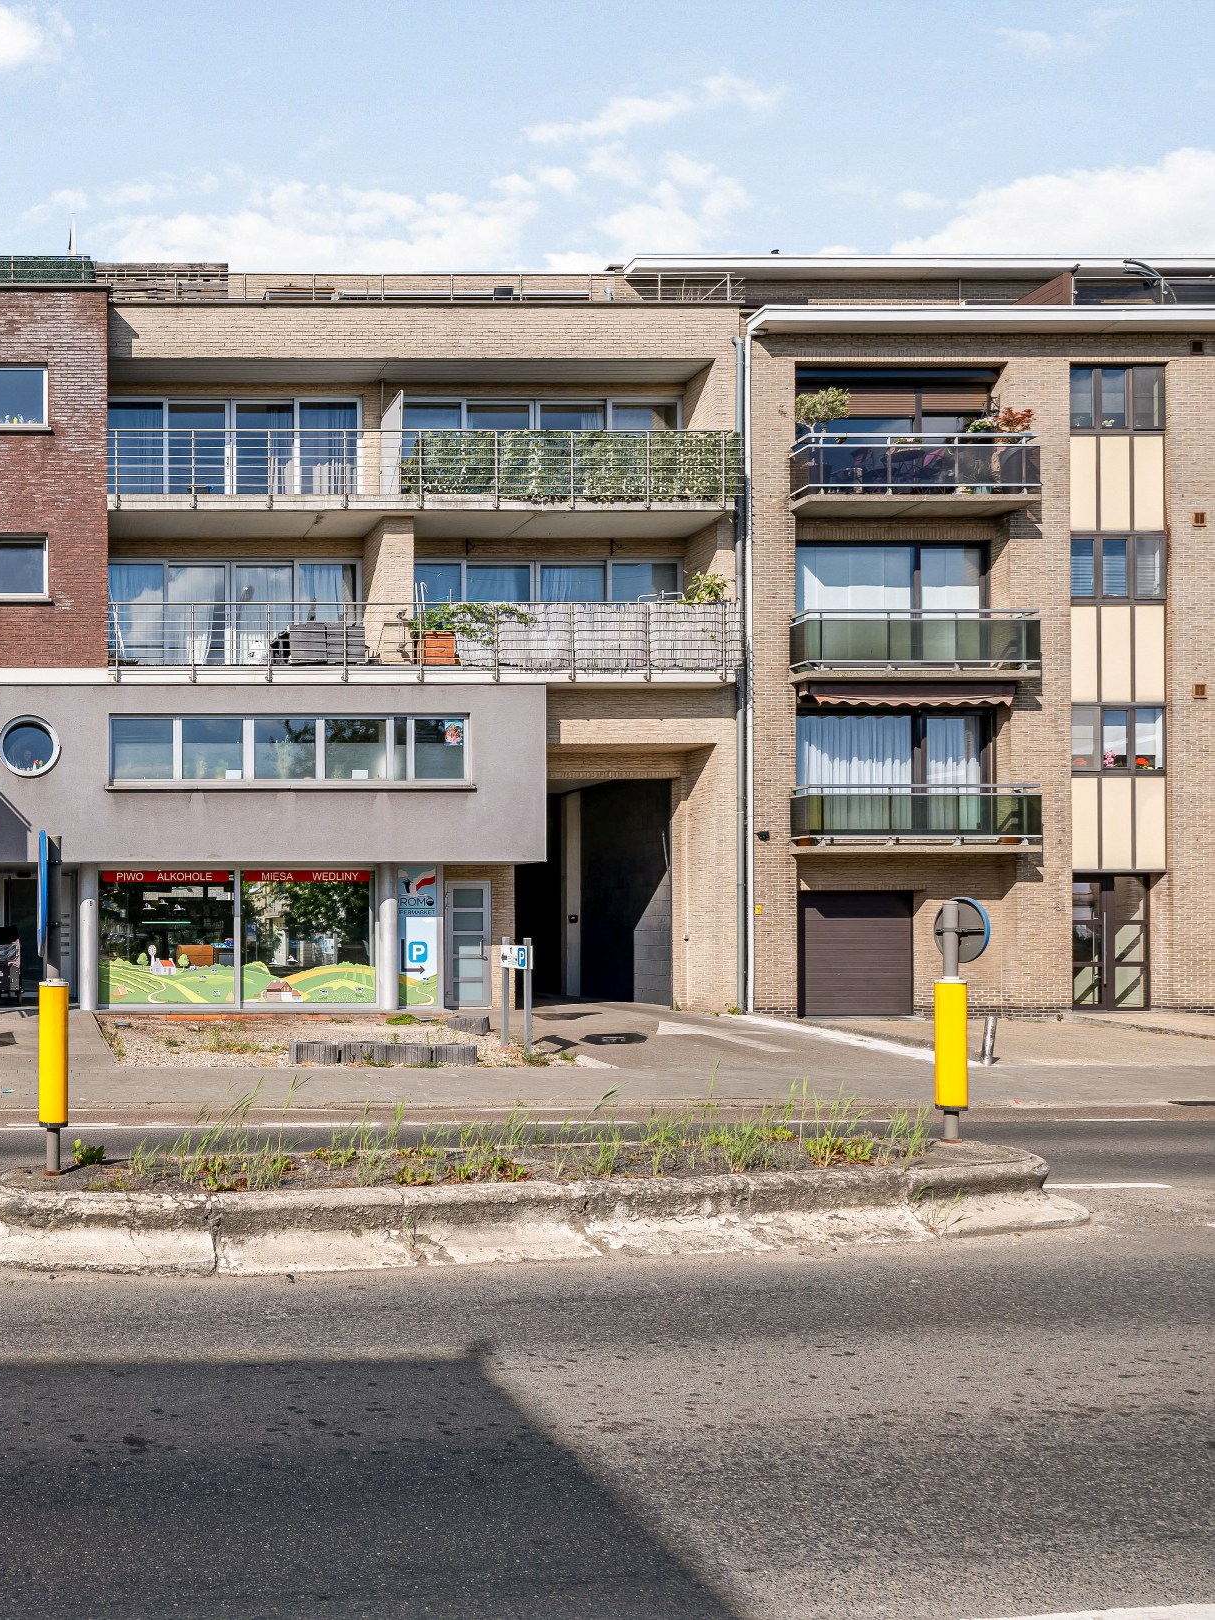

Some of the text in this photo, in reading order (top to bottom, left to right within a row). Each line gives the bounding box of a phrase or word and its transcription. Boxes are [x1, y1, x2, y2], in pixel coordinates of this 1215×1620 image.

[116, 872, 213, 881] PIWO ALKOHOLE
[398, 897, 435, 907] ROMO
[412, 944, 426, 961] P
[518, 950, 525, 965] P
